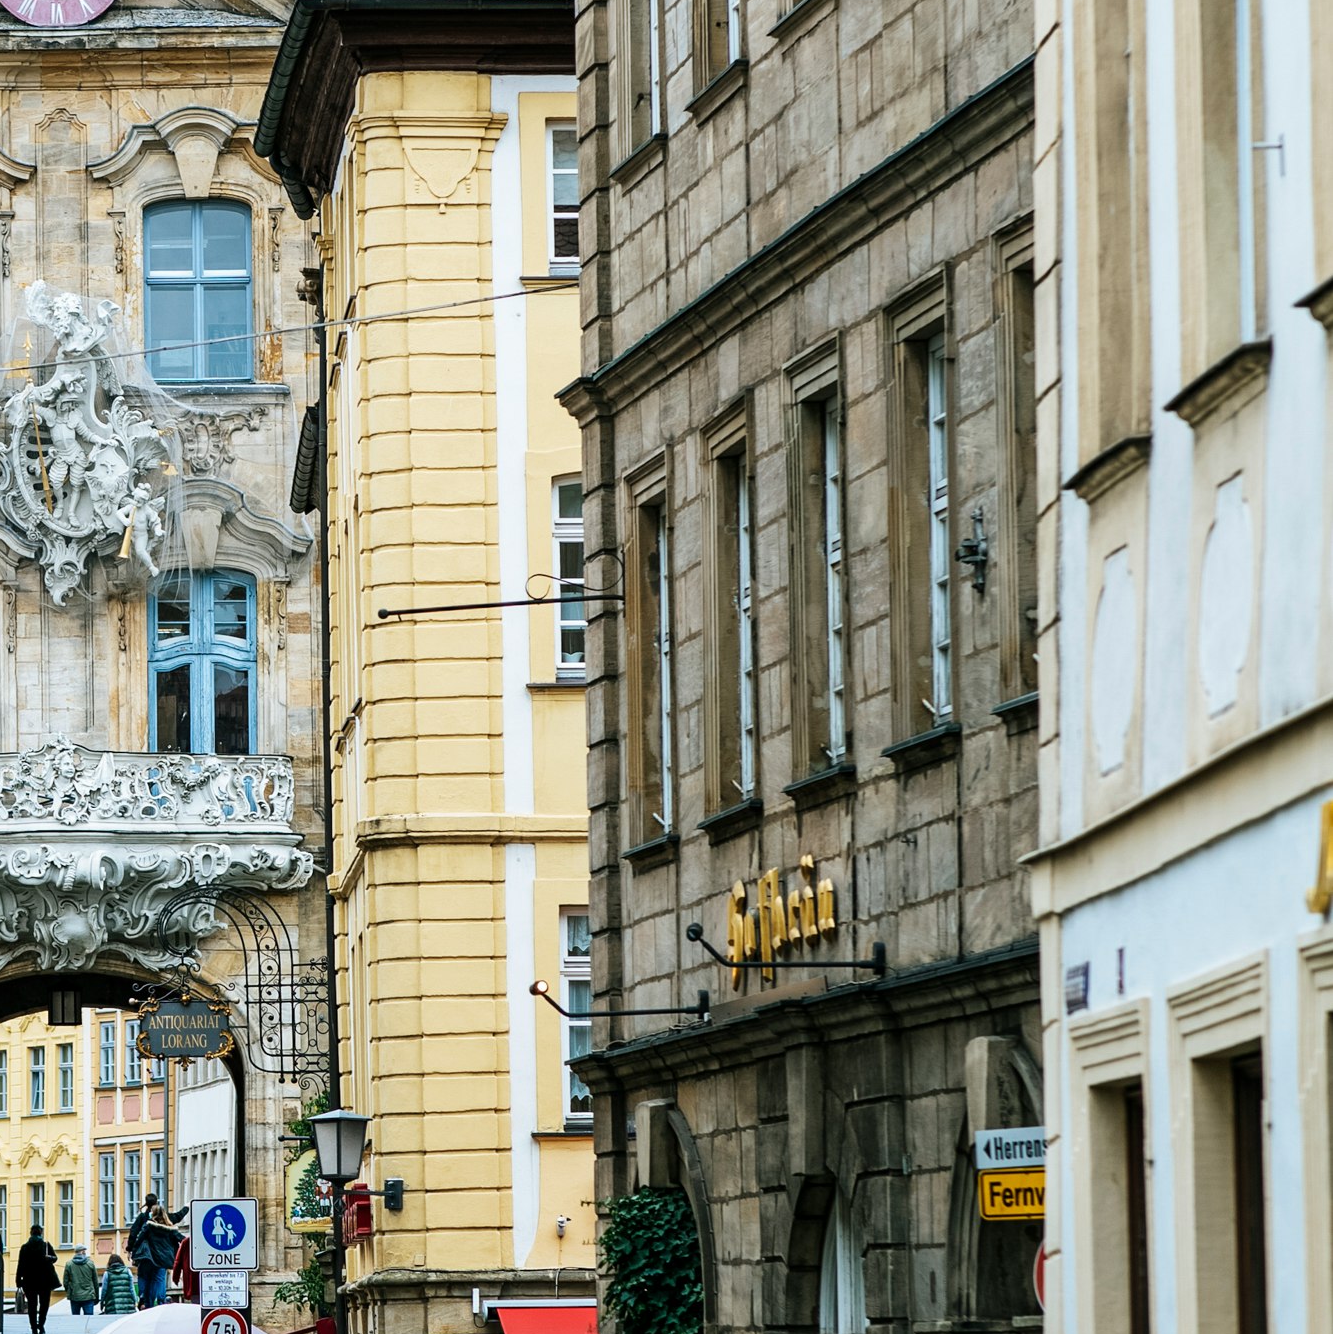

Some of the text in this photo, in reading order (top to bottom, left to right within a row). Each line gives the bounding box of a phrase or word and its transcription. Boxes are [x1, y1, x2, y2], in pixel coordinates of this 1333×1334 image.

[51, 3, 64, 24] VI
[148, 1014, 221, 1032] ANTIQUARIAT
[161, 1034, 207, 1048] LORANG
[207, 1253, 241, 1265] ZONE
